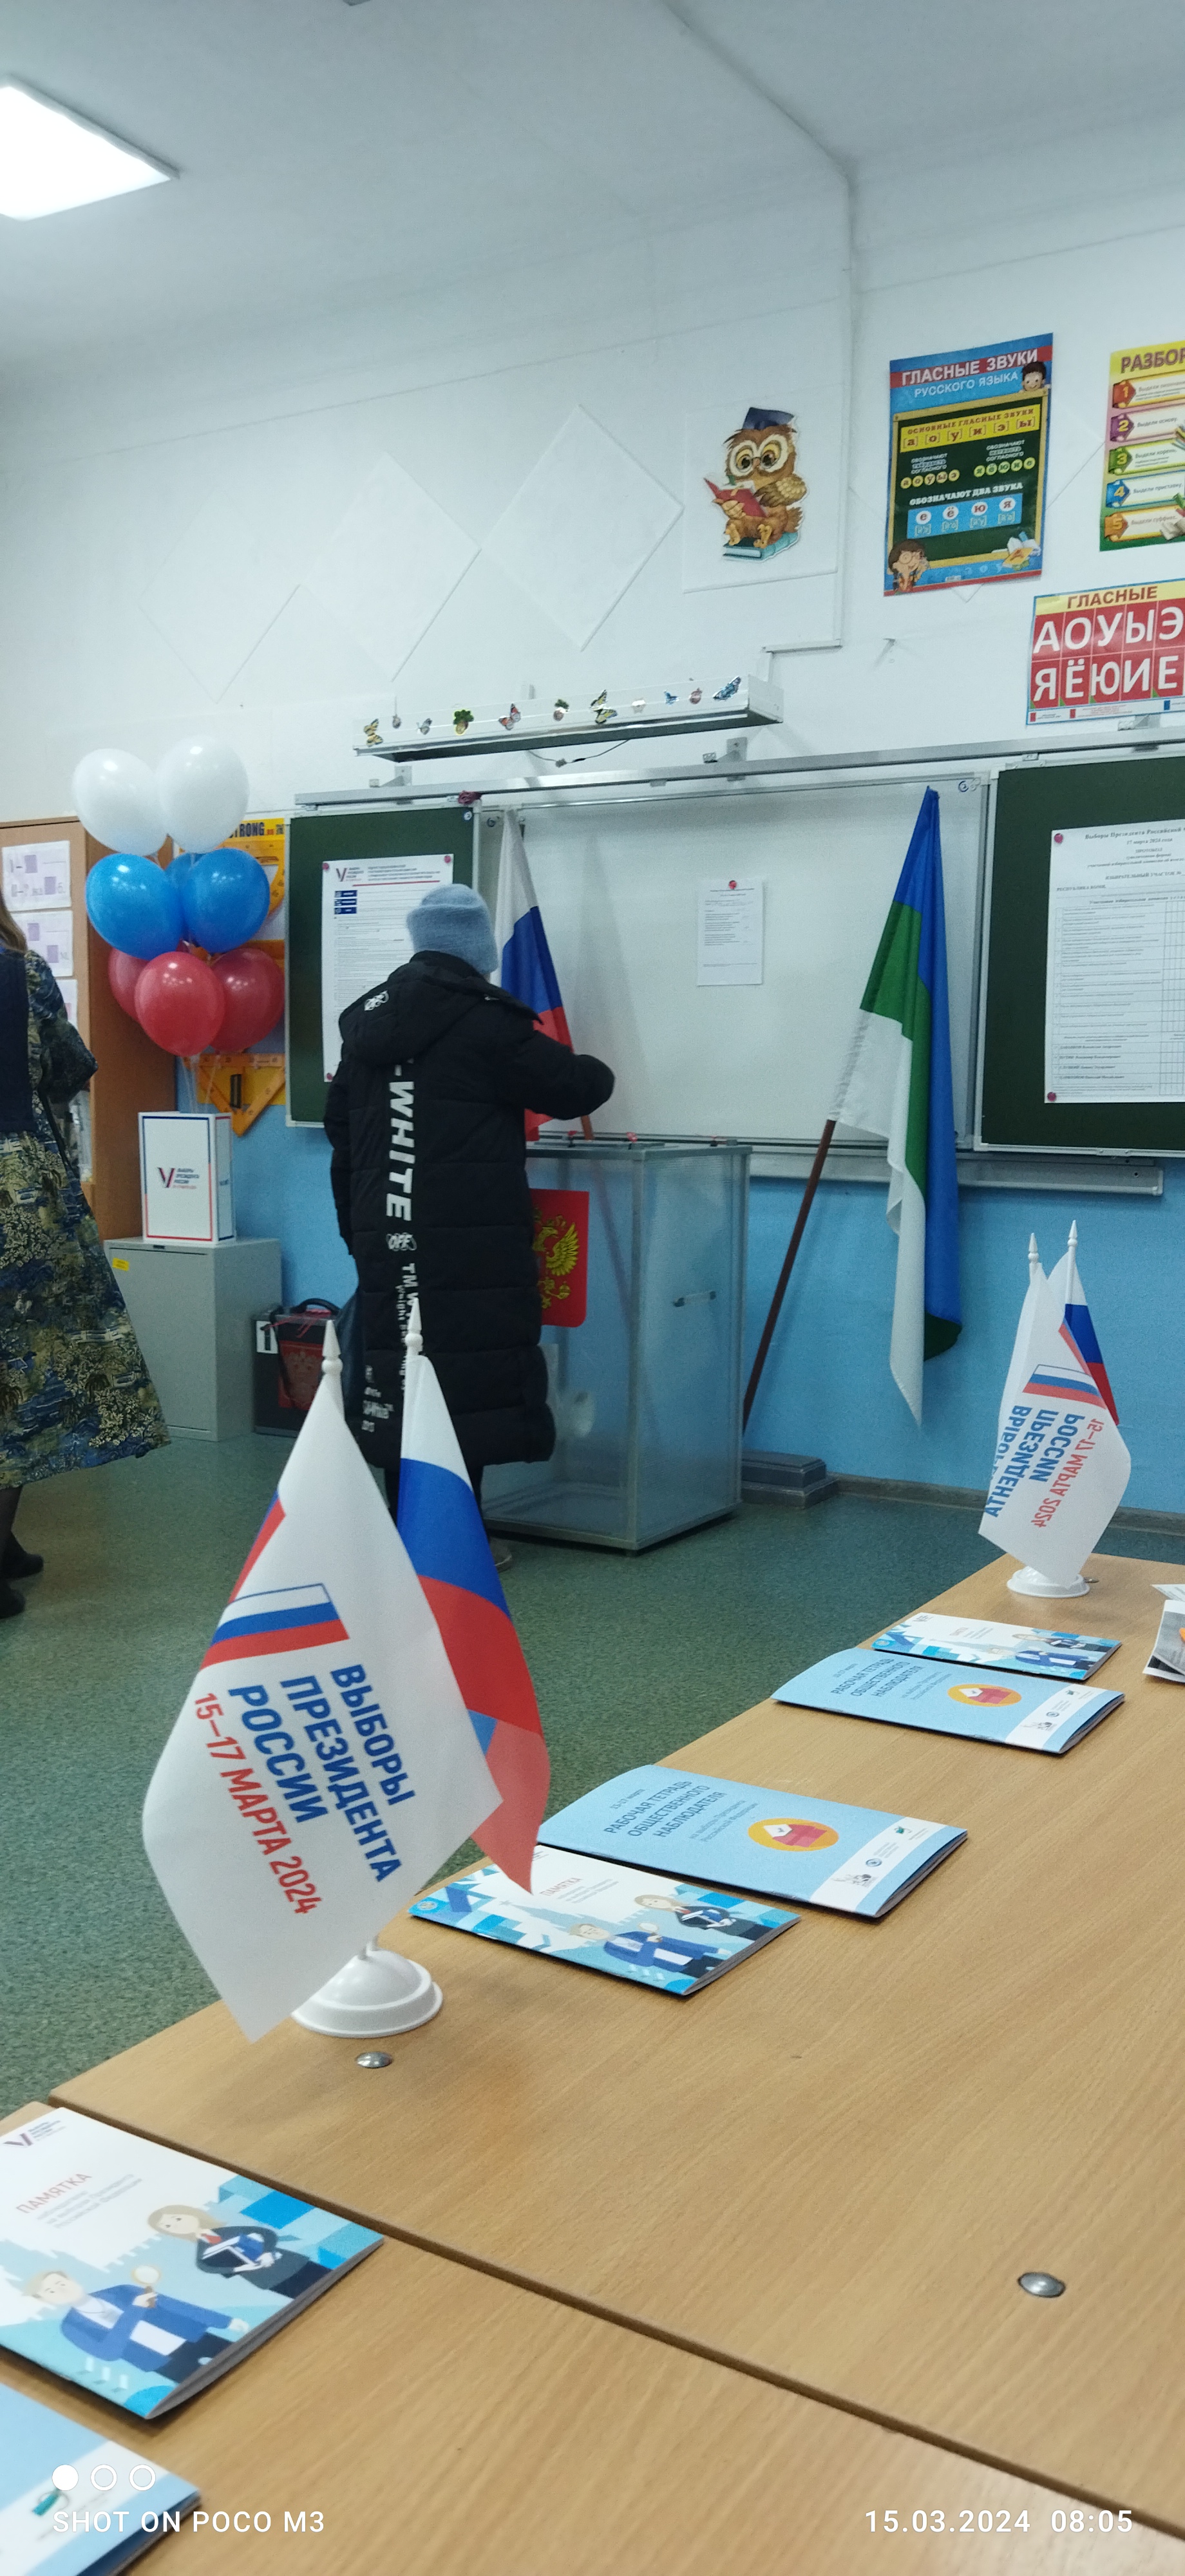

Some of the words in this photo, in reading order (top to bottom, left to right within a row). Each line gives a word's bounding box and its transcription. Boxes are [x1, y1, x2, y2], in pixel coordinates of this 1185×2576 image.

[902, 360, 980, 386] ГЛАСНЫЕ
[987, 348, 1038, 372] ЗВУКИ
[914, 379, 976, 398] РУССКОГО
[979, 371, 1019, 387] ЯЗЫКА
[907, 421, 956, 435] ОСНОВНЫЕ
[958, 414, 1001, 427] ГЛАСНЫЕ
[1004, 408, 1034, 419] ЗВУКИ
[1119, 419, 1129, 431] 2
[1117, 453, 1127, 465] 3
[909, 491, 971, 506] ОБОЗНАЧАЮТ
[972, 488, 991, 498] ДВА
[992, 482, 1023, 494] ЗВУКА
[1114, 486, 1125, 497] 4
[1067, 585, 1158, 609] ГЛАСНЫЕ
[228, 1684, 329, 1823] РОССИИ
[330, 1663, 416, 1806] ВЫБОРЫ
[280, 1675, 403, 1882] ПРЕЗИДЕНТА
[603, 1802, 654, 1833] РАБОЧАЯ
[647, 1781, 693, 1803] ТЕТРАДЬ
[627, 1785, 710, 1837] ОБЩЕСТВЕННОГО
[652, 1792, 728, 1837] НАБЛЮДАТЕЛЯ
[221, 1768, 293, 1856] МАРТА
[269, 1856, 323, 1915] 2024
[16, 2173, 92, 2213] ПАМЯТКА
